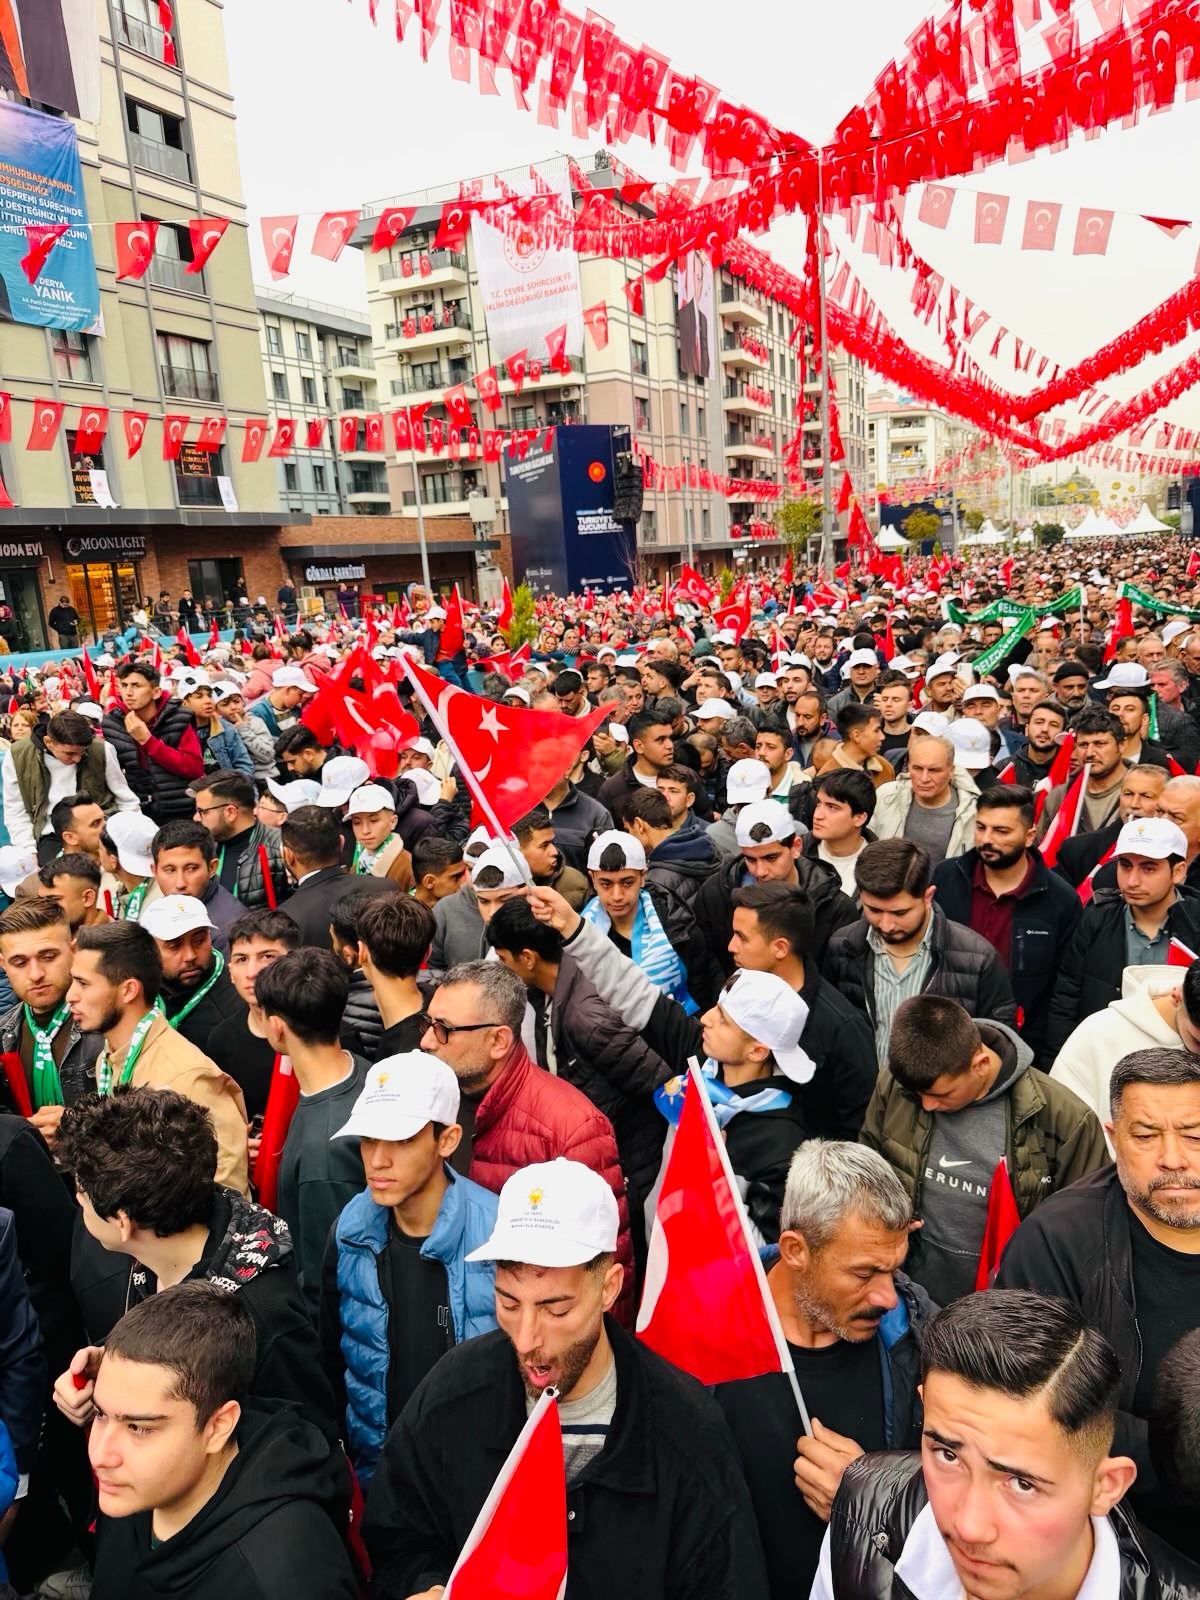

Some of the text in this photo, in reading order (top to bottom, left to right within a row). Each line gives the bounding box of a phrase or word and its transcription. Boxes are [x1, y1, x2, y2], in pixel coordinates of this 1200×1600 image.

[57, 215, 69, 225] VE
[38, 276, 66, 290] DERYA
[33, 284, 76, 304] YANIK
[25, 541, 43, 556] EVİ
[81, 536, 146, 550] MOONLIGHT
